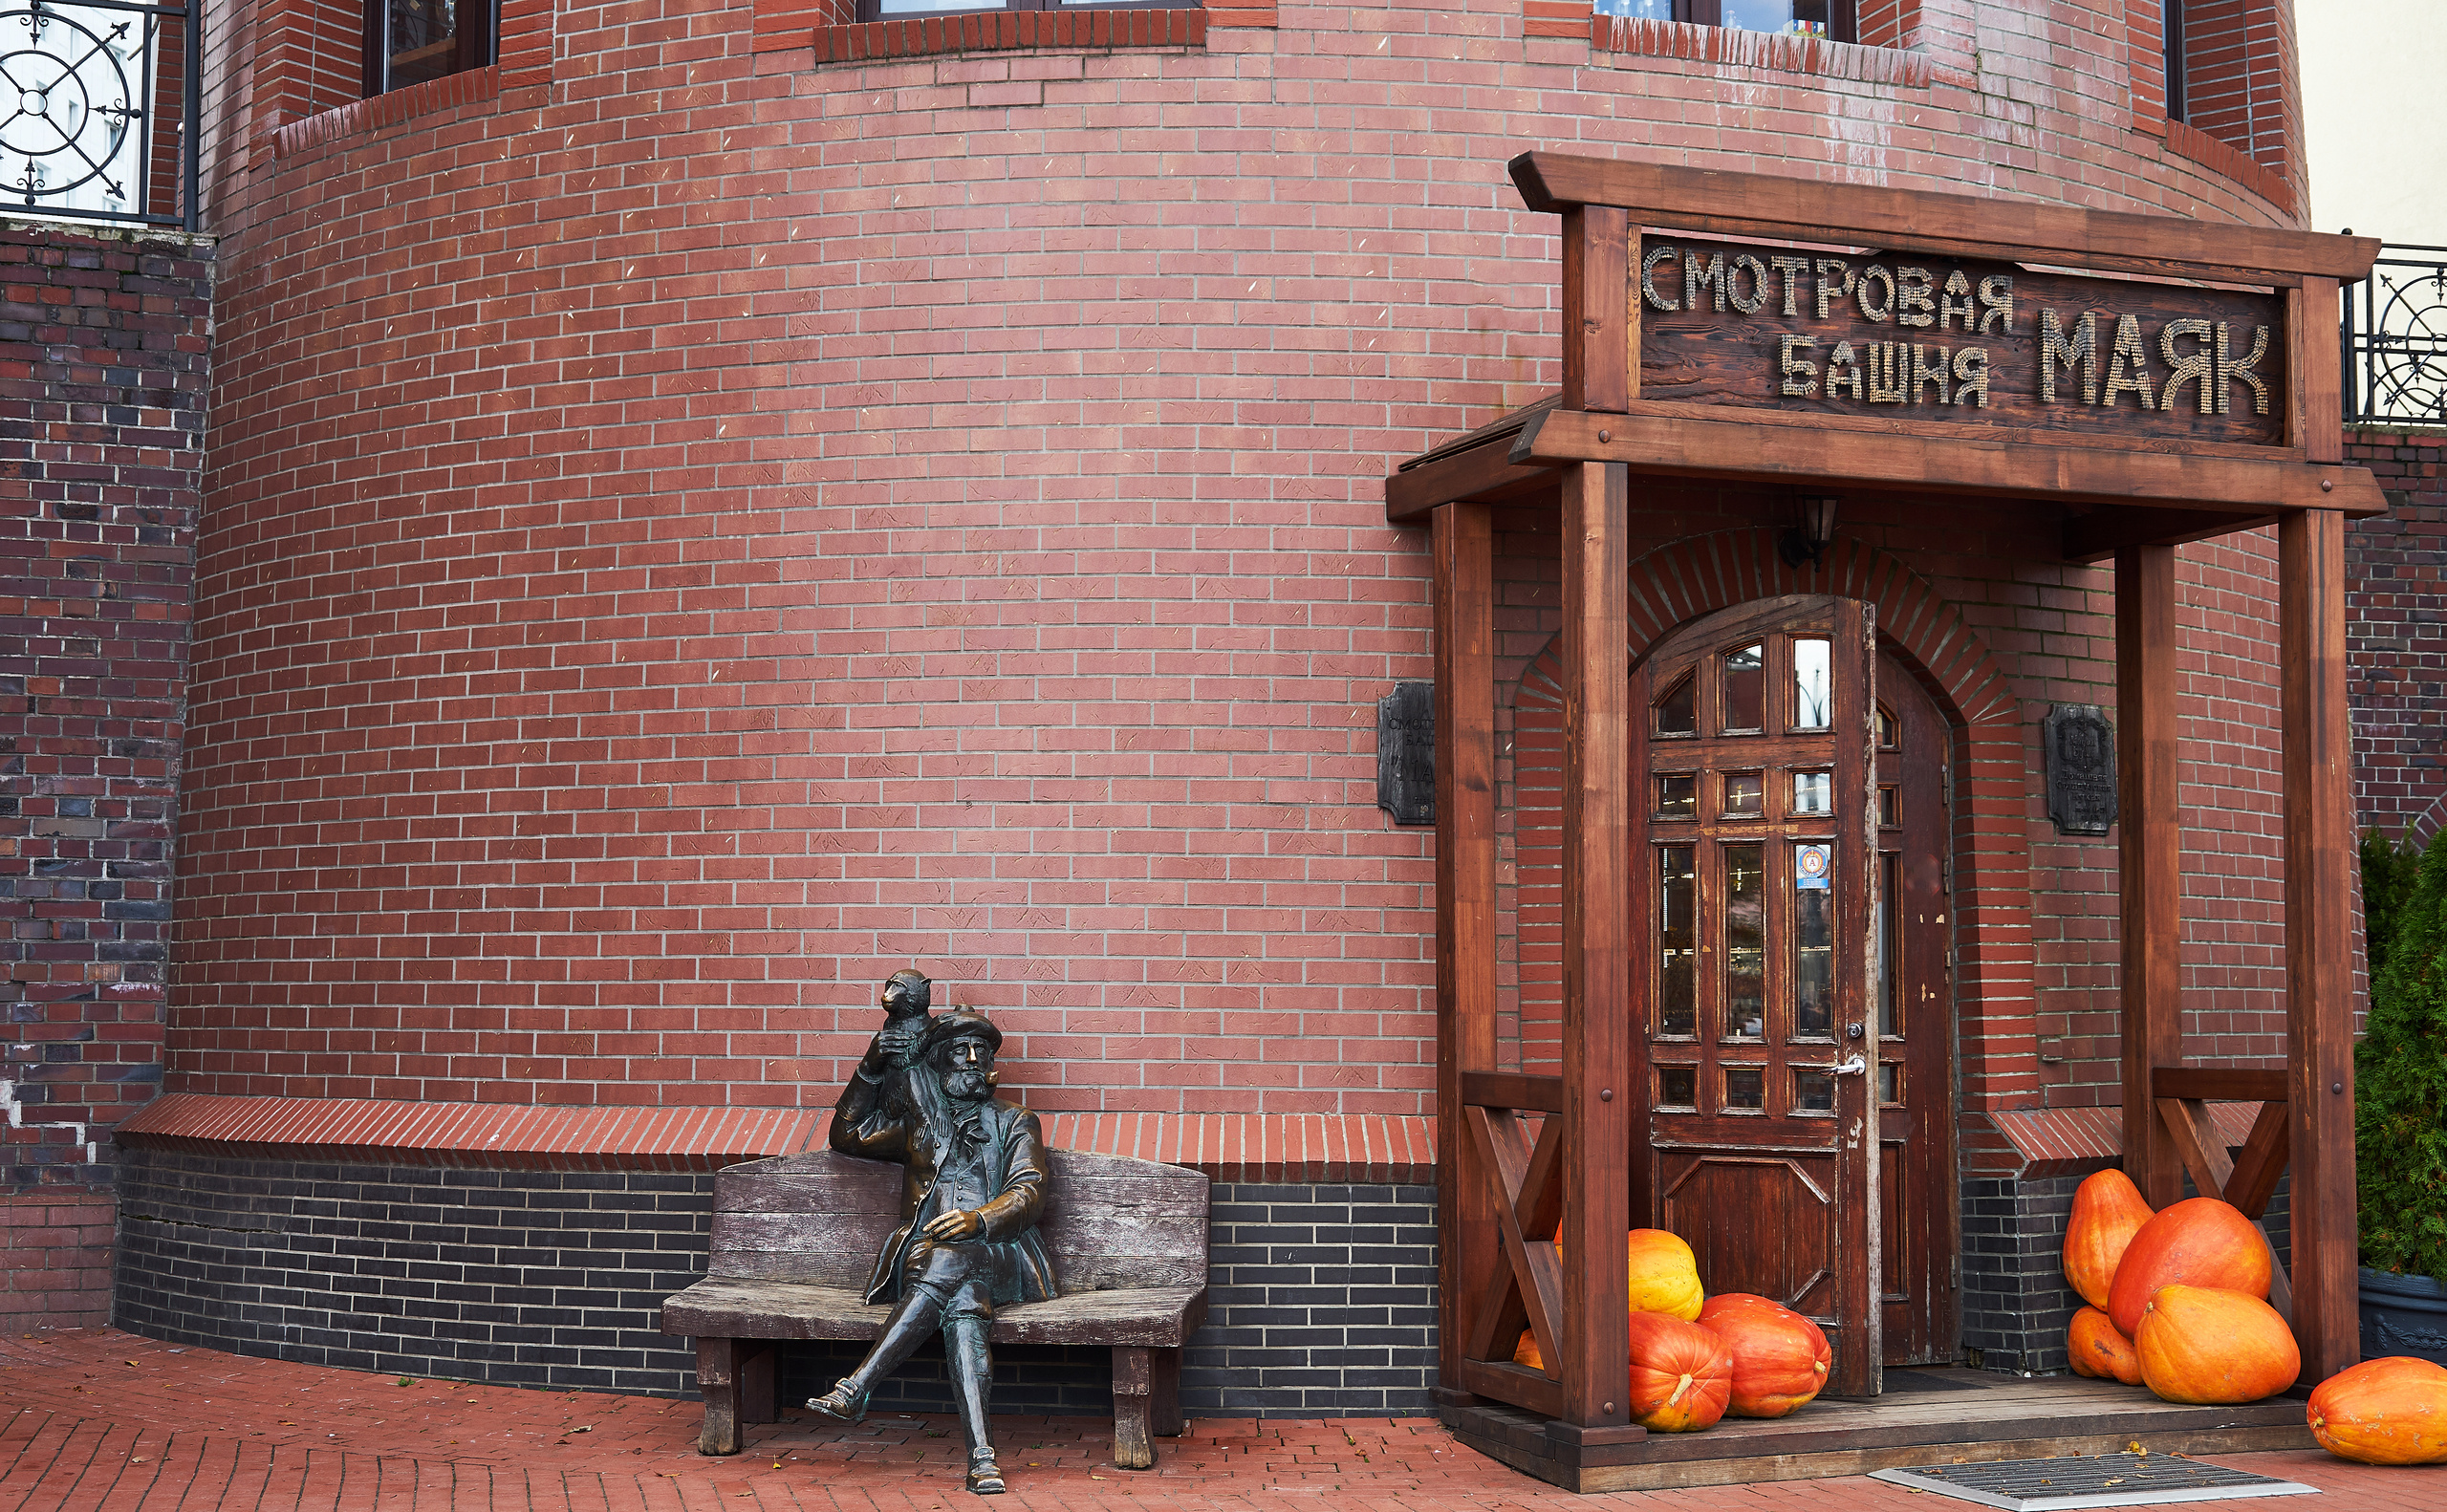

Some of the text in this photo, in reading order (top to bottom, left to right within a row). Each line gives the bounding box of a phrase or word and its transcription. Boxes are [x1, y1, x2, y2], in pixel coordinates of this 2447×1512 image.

[1641, 245, 2013, 334] СМОТРОВАЯ
[1777, 333, 1989, 409] БАШНЯ
[2035, 307, 2270, 415] МАЯК
